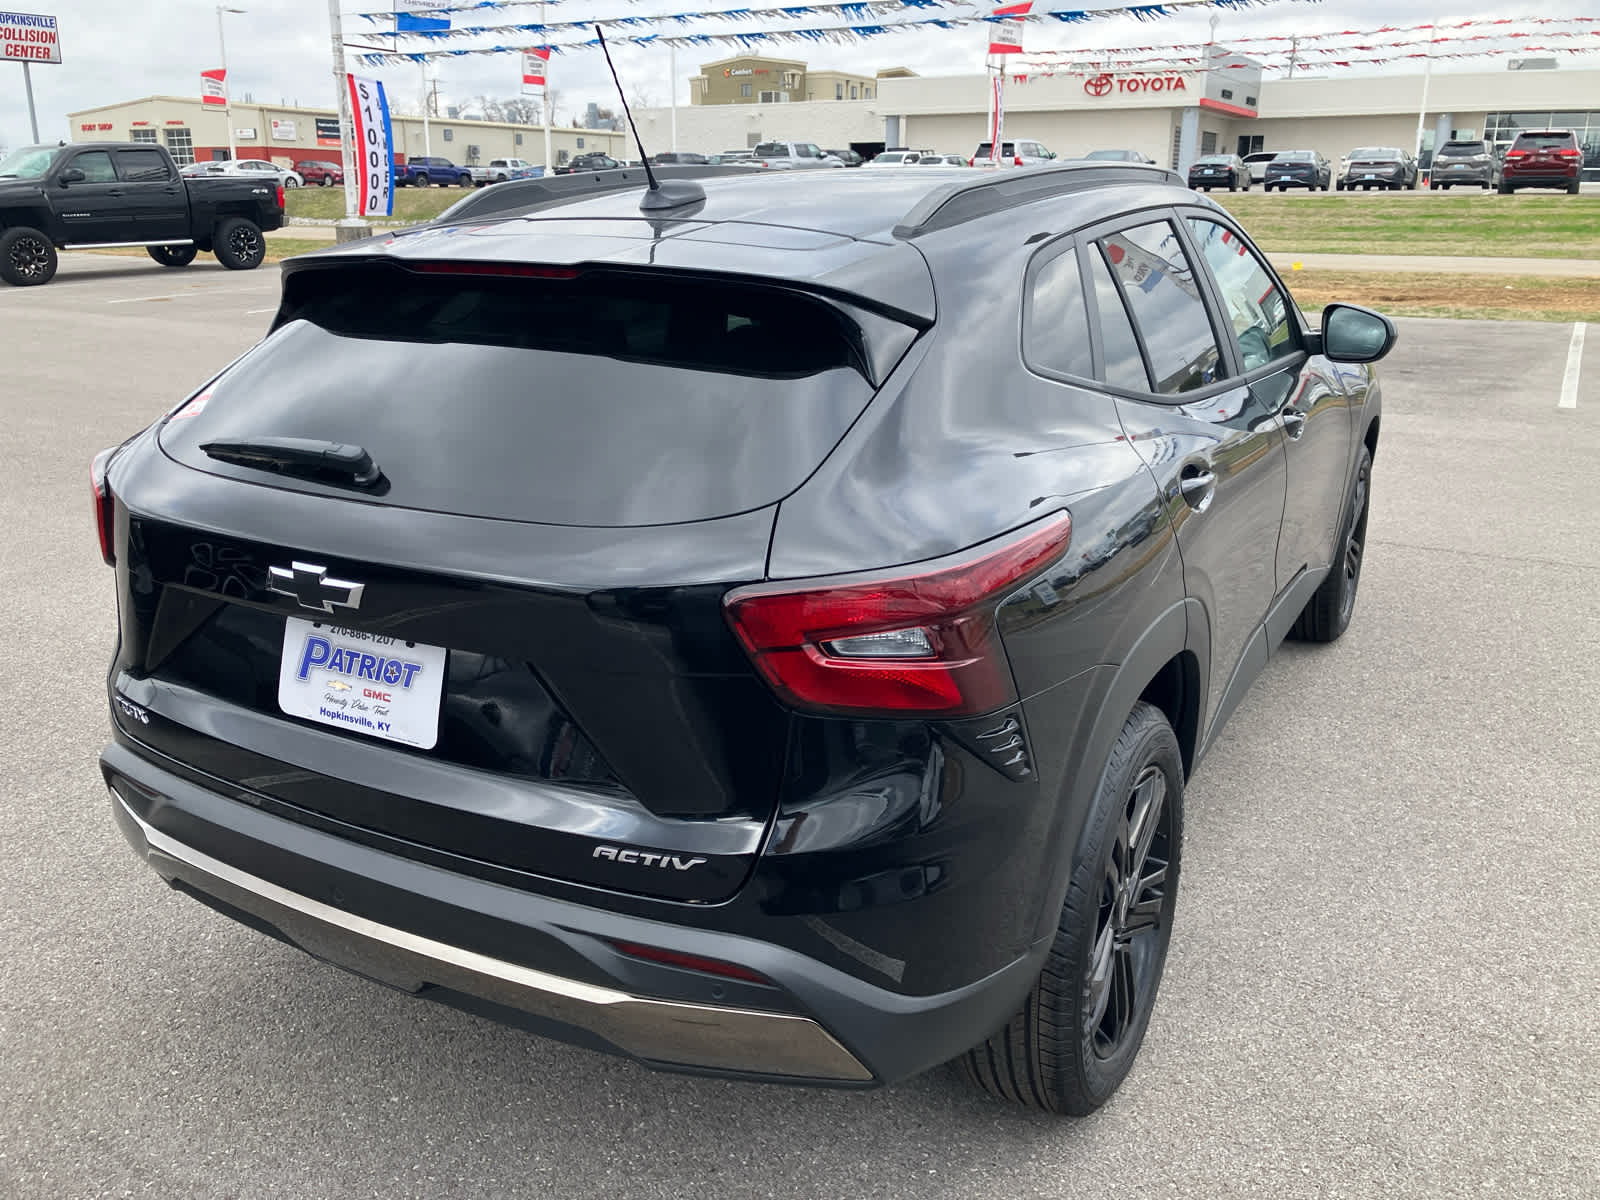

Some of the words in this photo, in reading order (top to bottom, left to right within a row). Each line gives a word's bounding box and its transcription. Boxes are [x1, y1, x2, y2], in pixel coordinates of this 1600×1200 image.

[5, 43, 51, 59] CENTER
[1117, 76, 1186, 92] TOYOTA
[330, 625, 396, 646] 270-886-1207
[297, 634, 423, 689] PATRIOT
[363, 688, 392, 702] GMC
[319, 706, 375, 730] Hopkinsville,
[377, 721, 391, 732] KY
[592, 845, 708, 871] ACTIV
